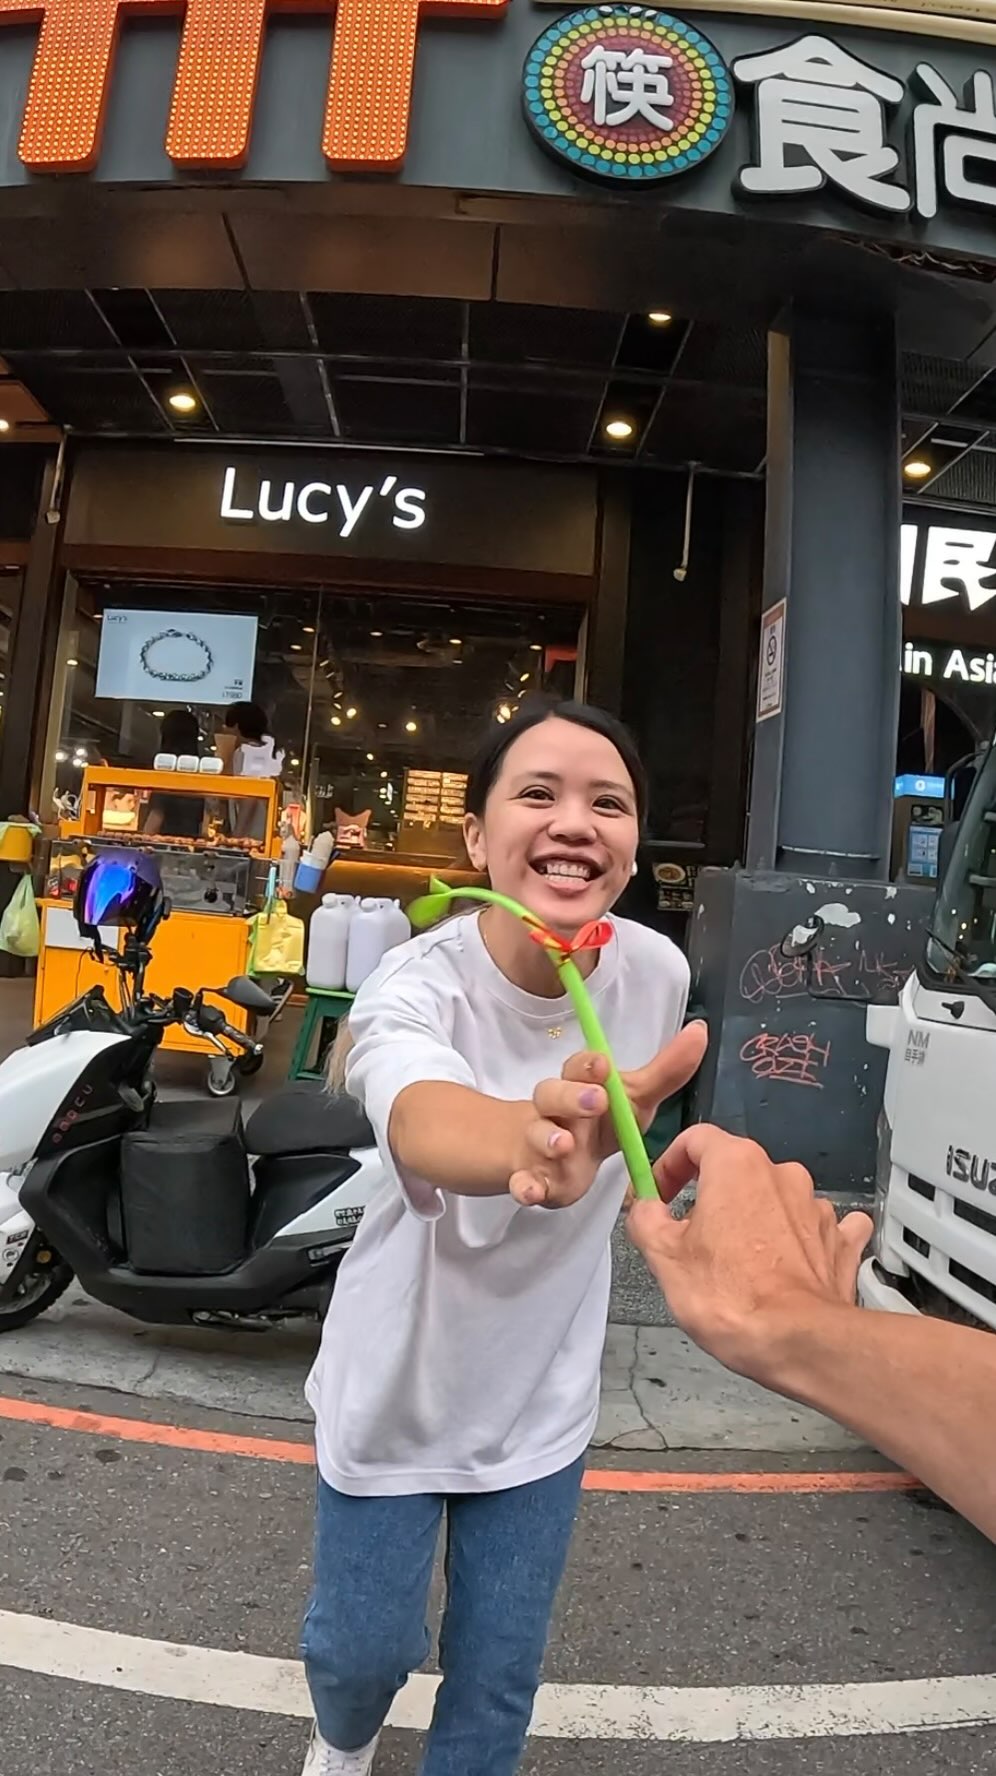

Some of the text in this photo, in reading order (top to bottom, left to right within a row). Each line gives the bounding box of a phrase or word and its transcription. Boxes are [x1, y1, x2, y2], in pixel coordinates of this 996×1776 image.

[580, 45, 674, 132] 筷
[732, 34, 996, 219] 食尚
[220, 466, 427, 538] Lucy's
[900, 523, 996, 612] 民
